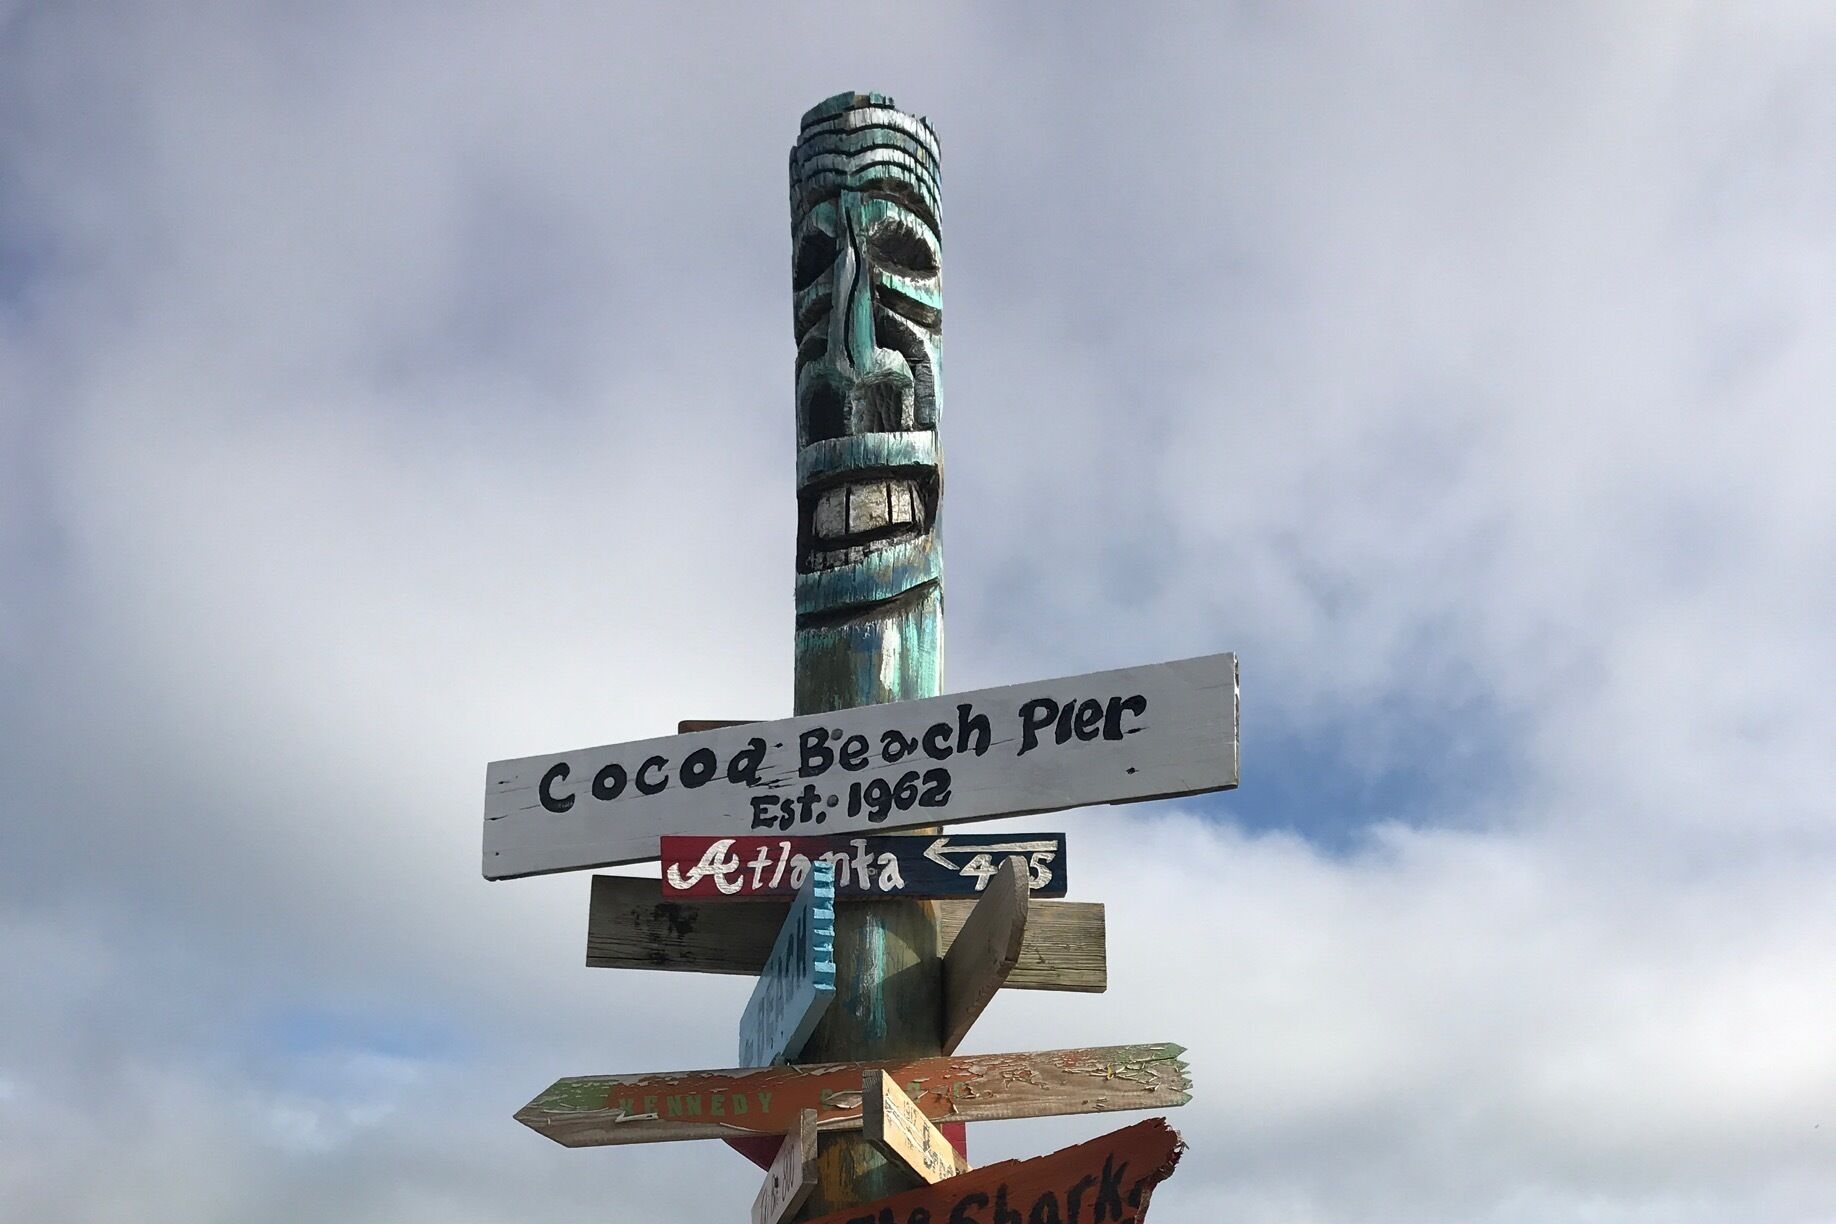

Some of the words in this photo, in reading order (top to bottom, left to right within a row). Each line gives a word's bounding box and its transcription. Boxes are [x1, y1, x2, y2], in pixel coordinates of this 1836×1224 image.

[799, 703, 991, 778] Beach
[1017, 694, 1147, 757] Pier
[750, 796, 827, 832] Est.
[848, 768, 951, 824] 1962
[959, 852, 1056, 892] 45
